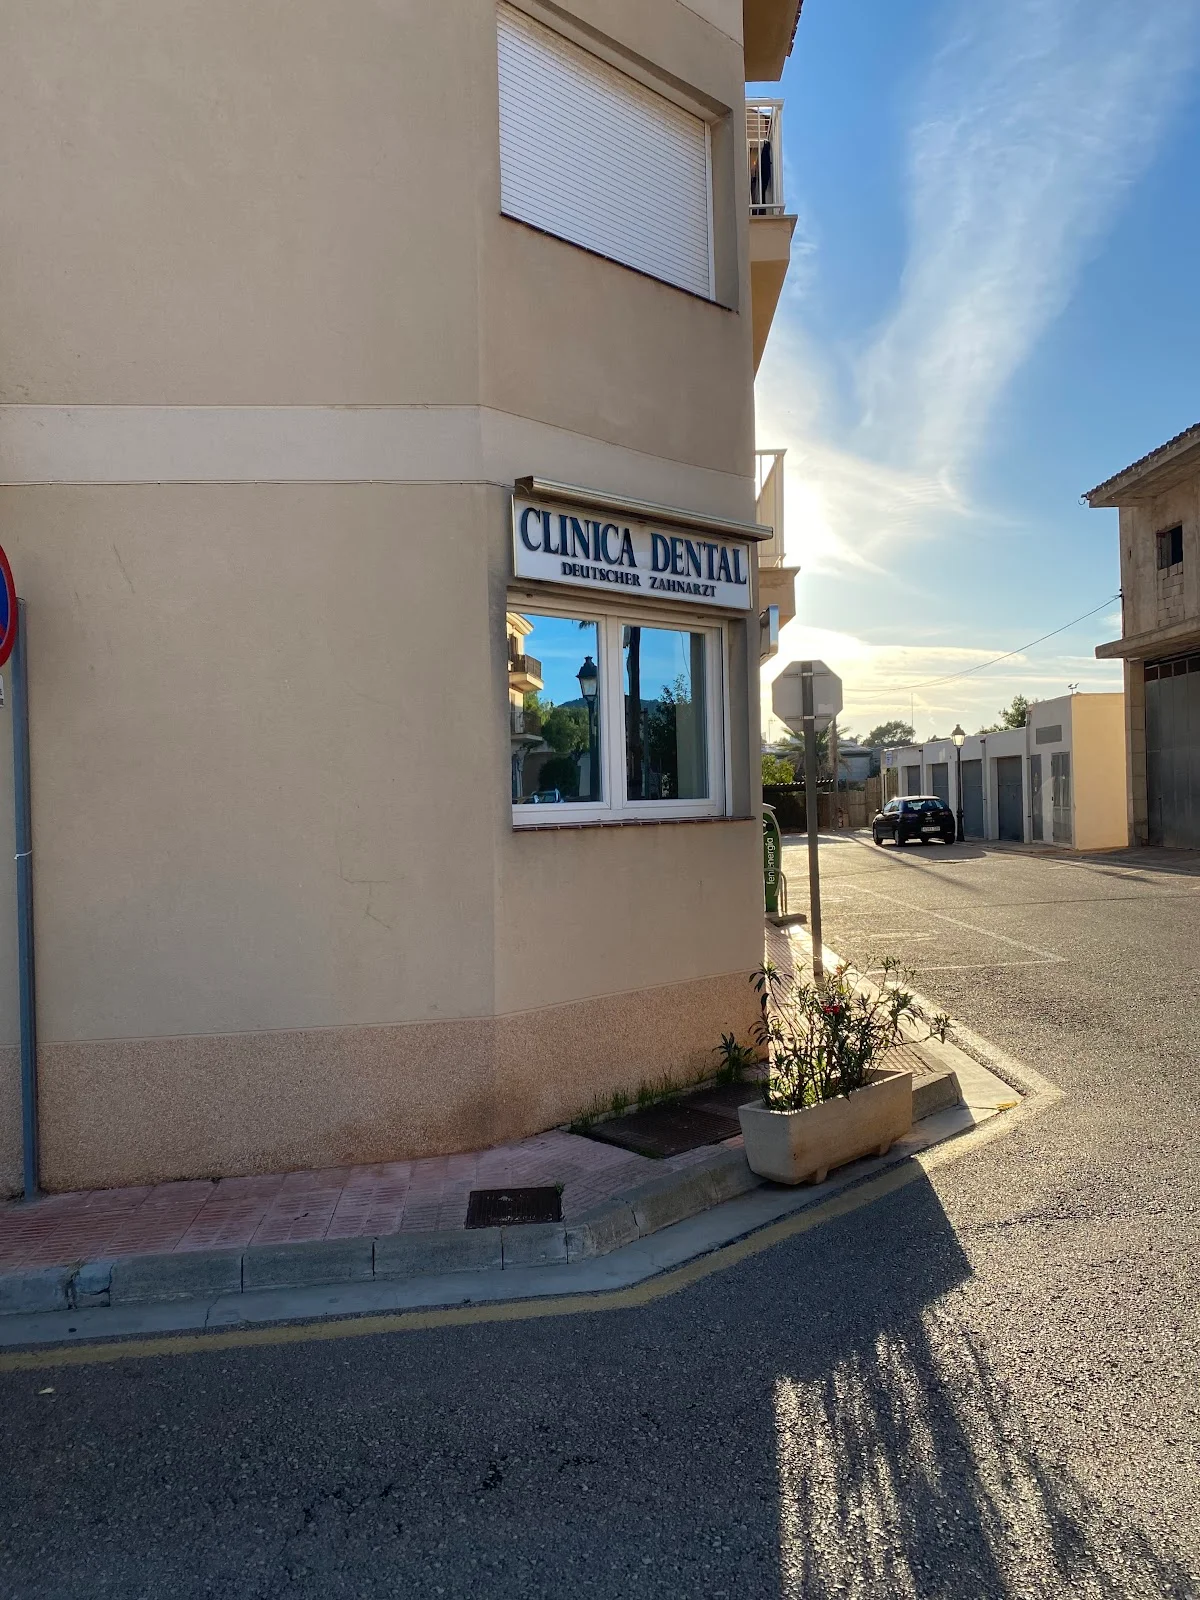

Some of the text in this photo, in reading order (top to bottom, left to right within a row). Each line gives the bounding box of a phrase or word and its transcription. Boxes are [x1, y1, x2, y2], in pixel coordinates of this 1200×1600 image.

[521, 507, 748, 585] CLINICA DENTAL
[562, 561, 717, 598] DEUTSCHER ZAHNARZT
